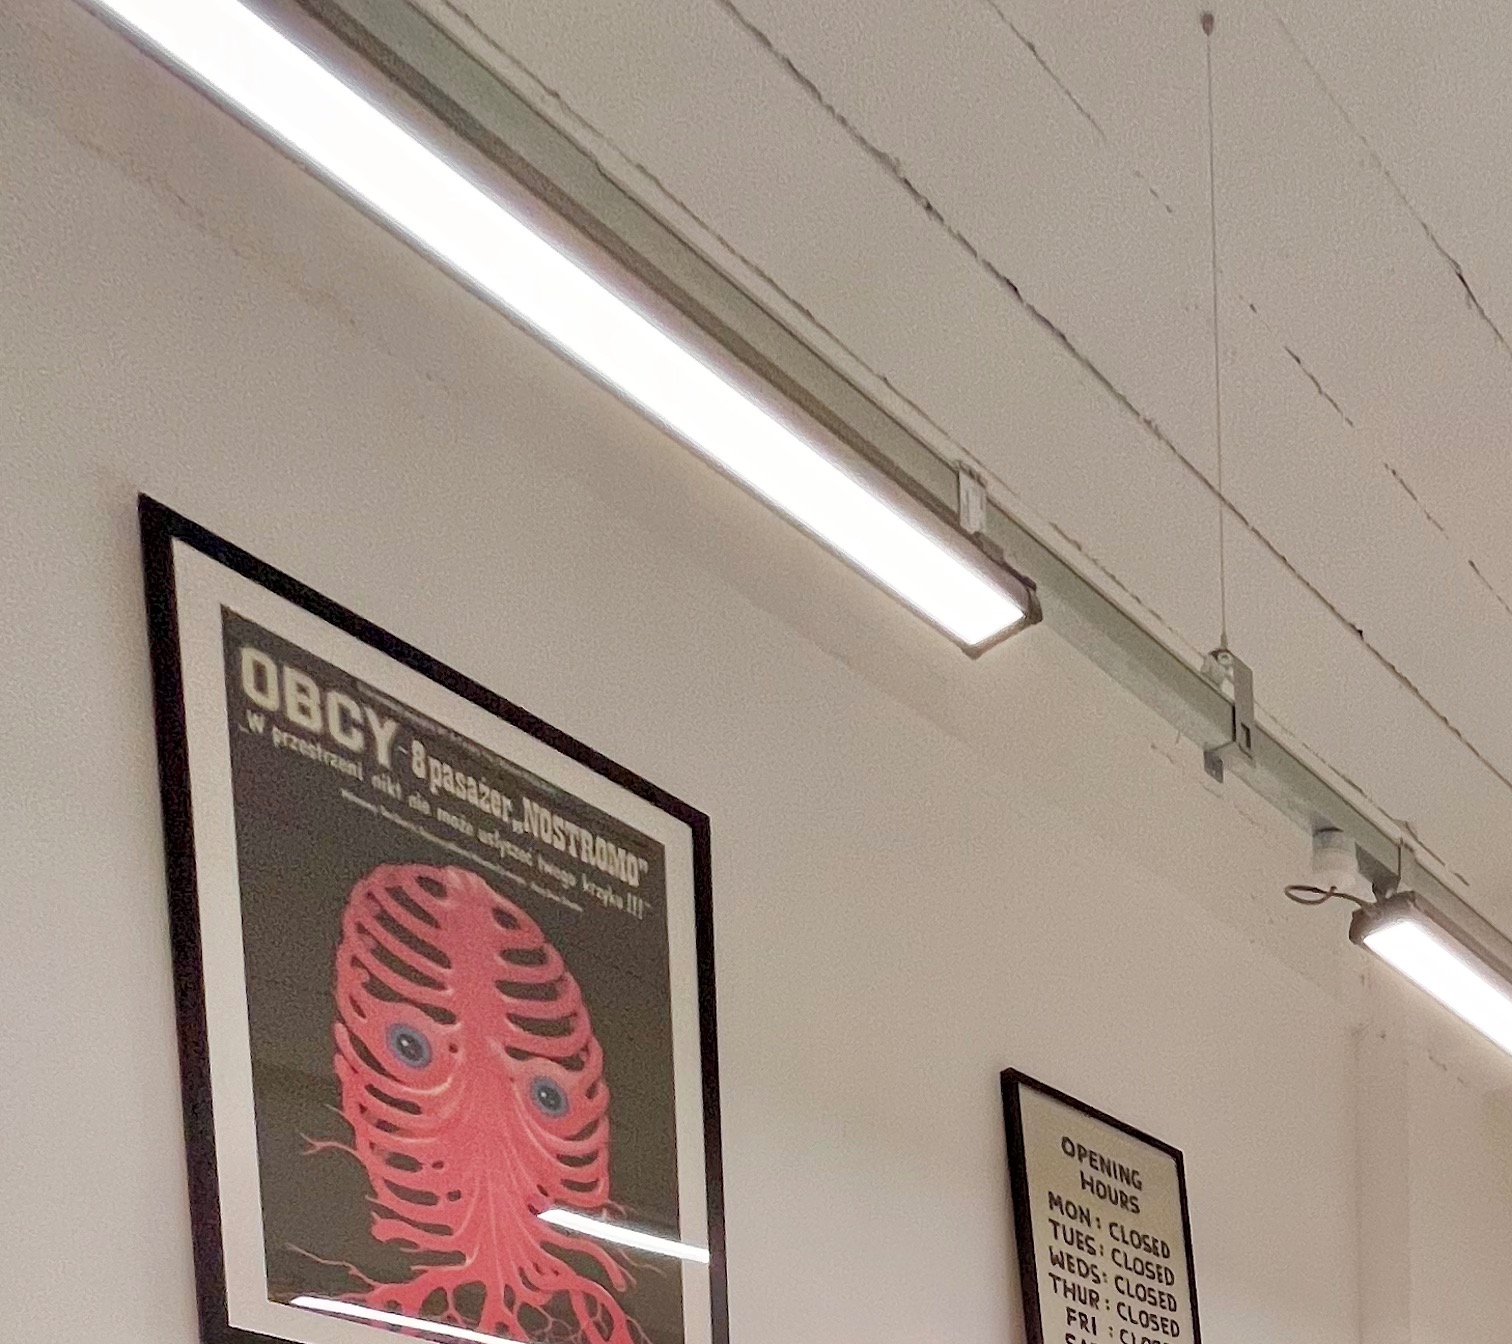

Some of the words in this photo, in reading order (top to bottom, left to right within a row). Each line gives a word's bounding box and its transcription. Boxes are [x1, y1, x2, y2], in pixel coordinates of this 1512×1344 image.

[241, 647, 400, 770] OBCY
[411, 739, 427, 779] 8
[428, 755, 513, 822] pasażer
[1061, 1136, 1143, 1191] OPENING
[1080, 1170, 1141, 1215] HOURS
[1109, 1221, 1171, 1260] CLOSED
[1111, 1247, 1175, 1287] CLOSED
[1114, 1275, 1178, 1313] CLOSED
[1116, 1300, 1180, 1338] CLOSED
